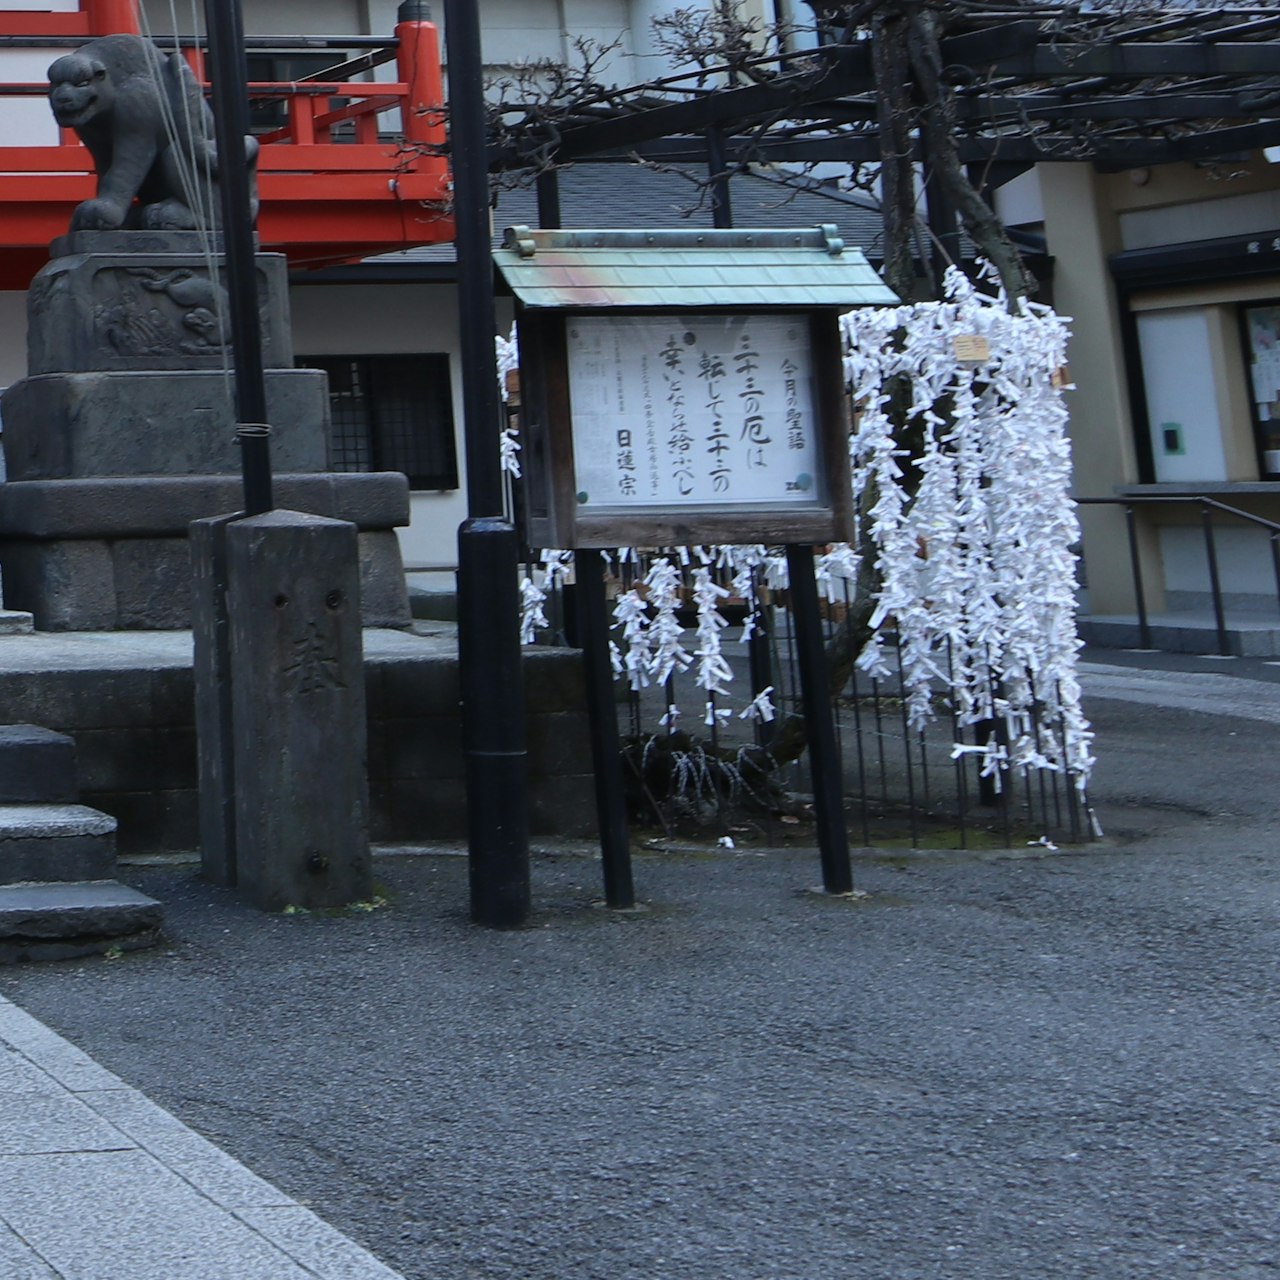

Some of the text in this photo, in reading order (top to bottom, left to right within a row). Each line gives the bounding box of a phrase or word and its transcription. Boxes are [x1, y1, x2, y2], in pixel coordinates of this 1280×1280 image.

[697, 352, 731, 493] 転じて三十三の
[733, 335, 771, 469] 三十三の厄は
[779, 358, 806, 450] 今月の聖語
[616, 429, 637, 496] 日蓮宗
